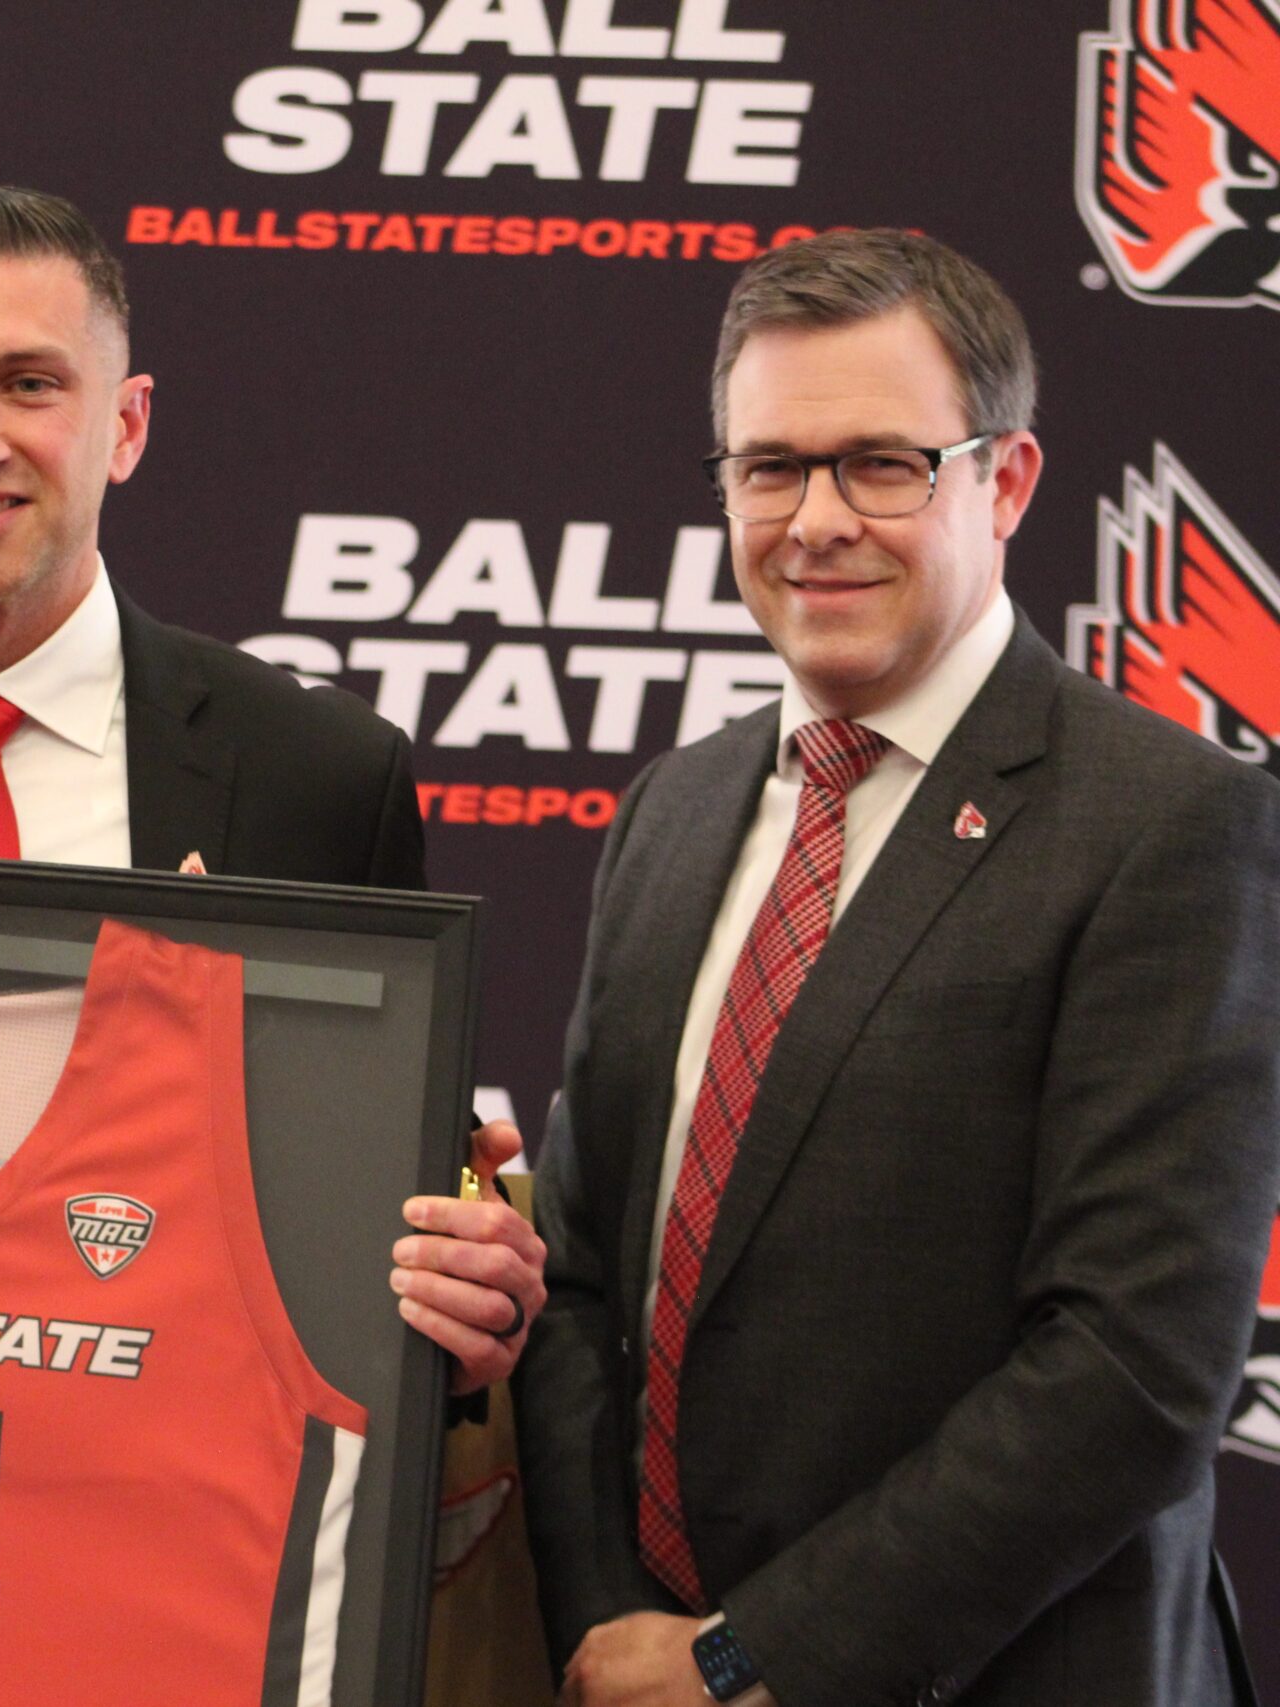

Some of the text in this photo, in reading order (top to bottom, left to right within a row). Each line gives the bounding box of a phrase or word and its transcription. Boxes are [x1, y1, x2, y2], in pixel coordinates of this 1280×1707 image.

[223, 67, 813, 187] STATE
[282, 514, 763, 634] BALL
[72, 1218, 146, 1246] MAC
